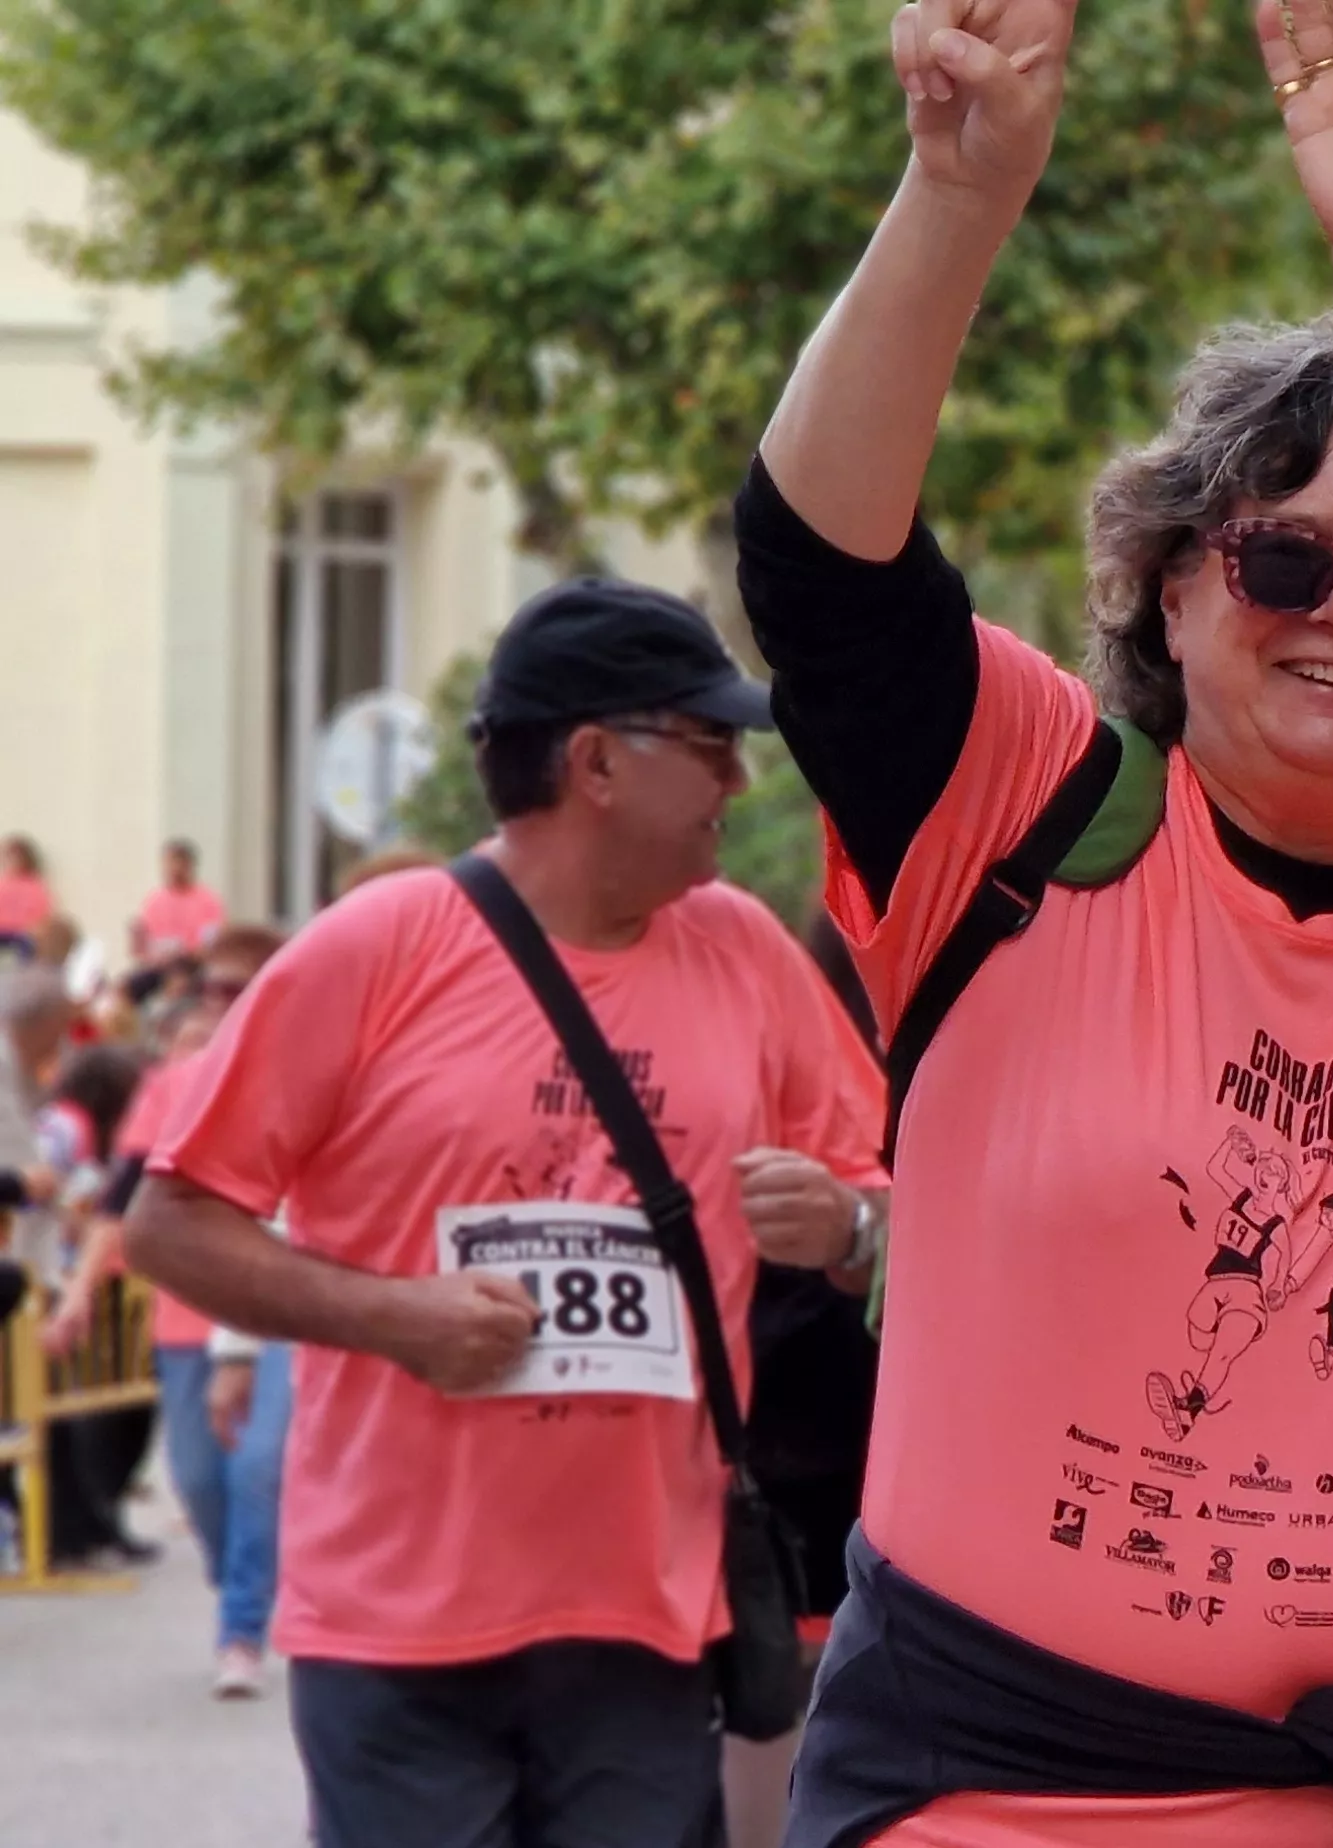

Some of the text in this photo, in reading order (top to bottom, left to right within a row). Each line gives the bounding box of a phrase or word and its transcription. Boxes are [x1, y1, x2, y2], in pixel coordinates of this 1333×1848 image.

[1215, 1060, 1271, 1123] POR
[1273, 1090, 1295, 1143] LA
[1226, 1218, 1250, 1248] 19
[470, 1240, 561, 1262] CONTRA
[565, 1240, 588, 1260] EL
[1140, 1446, 1194, 1468] avanza
[1216, 1503, 1276, 1522] Humeco
